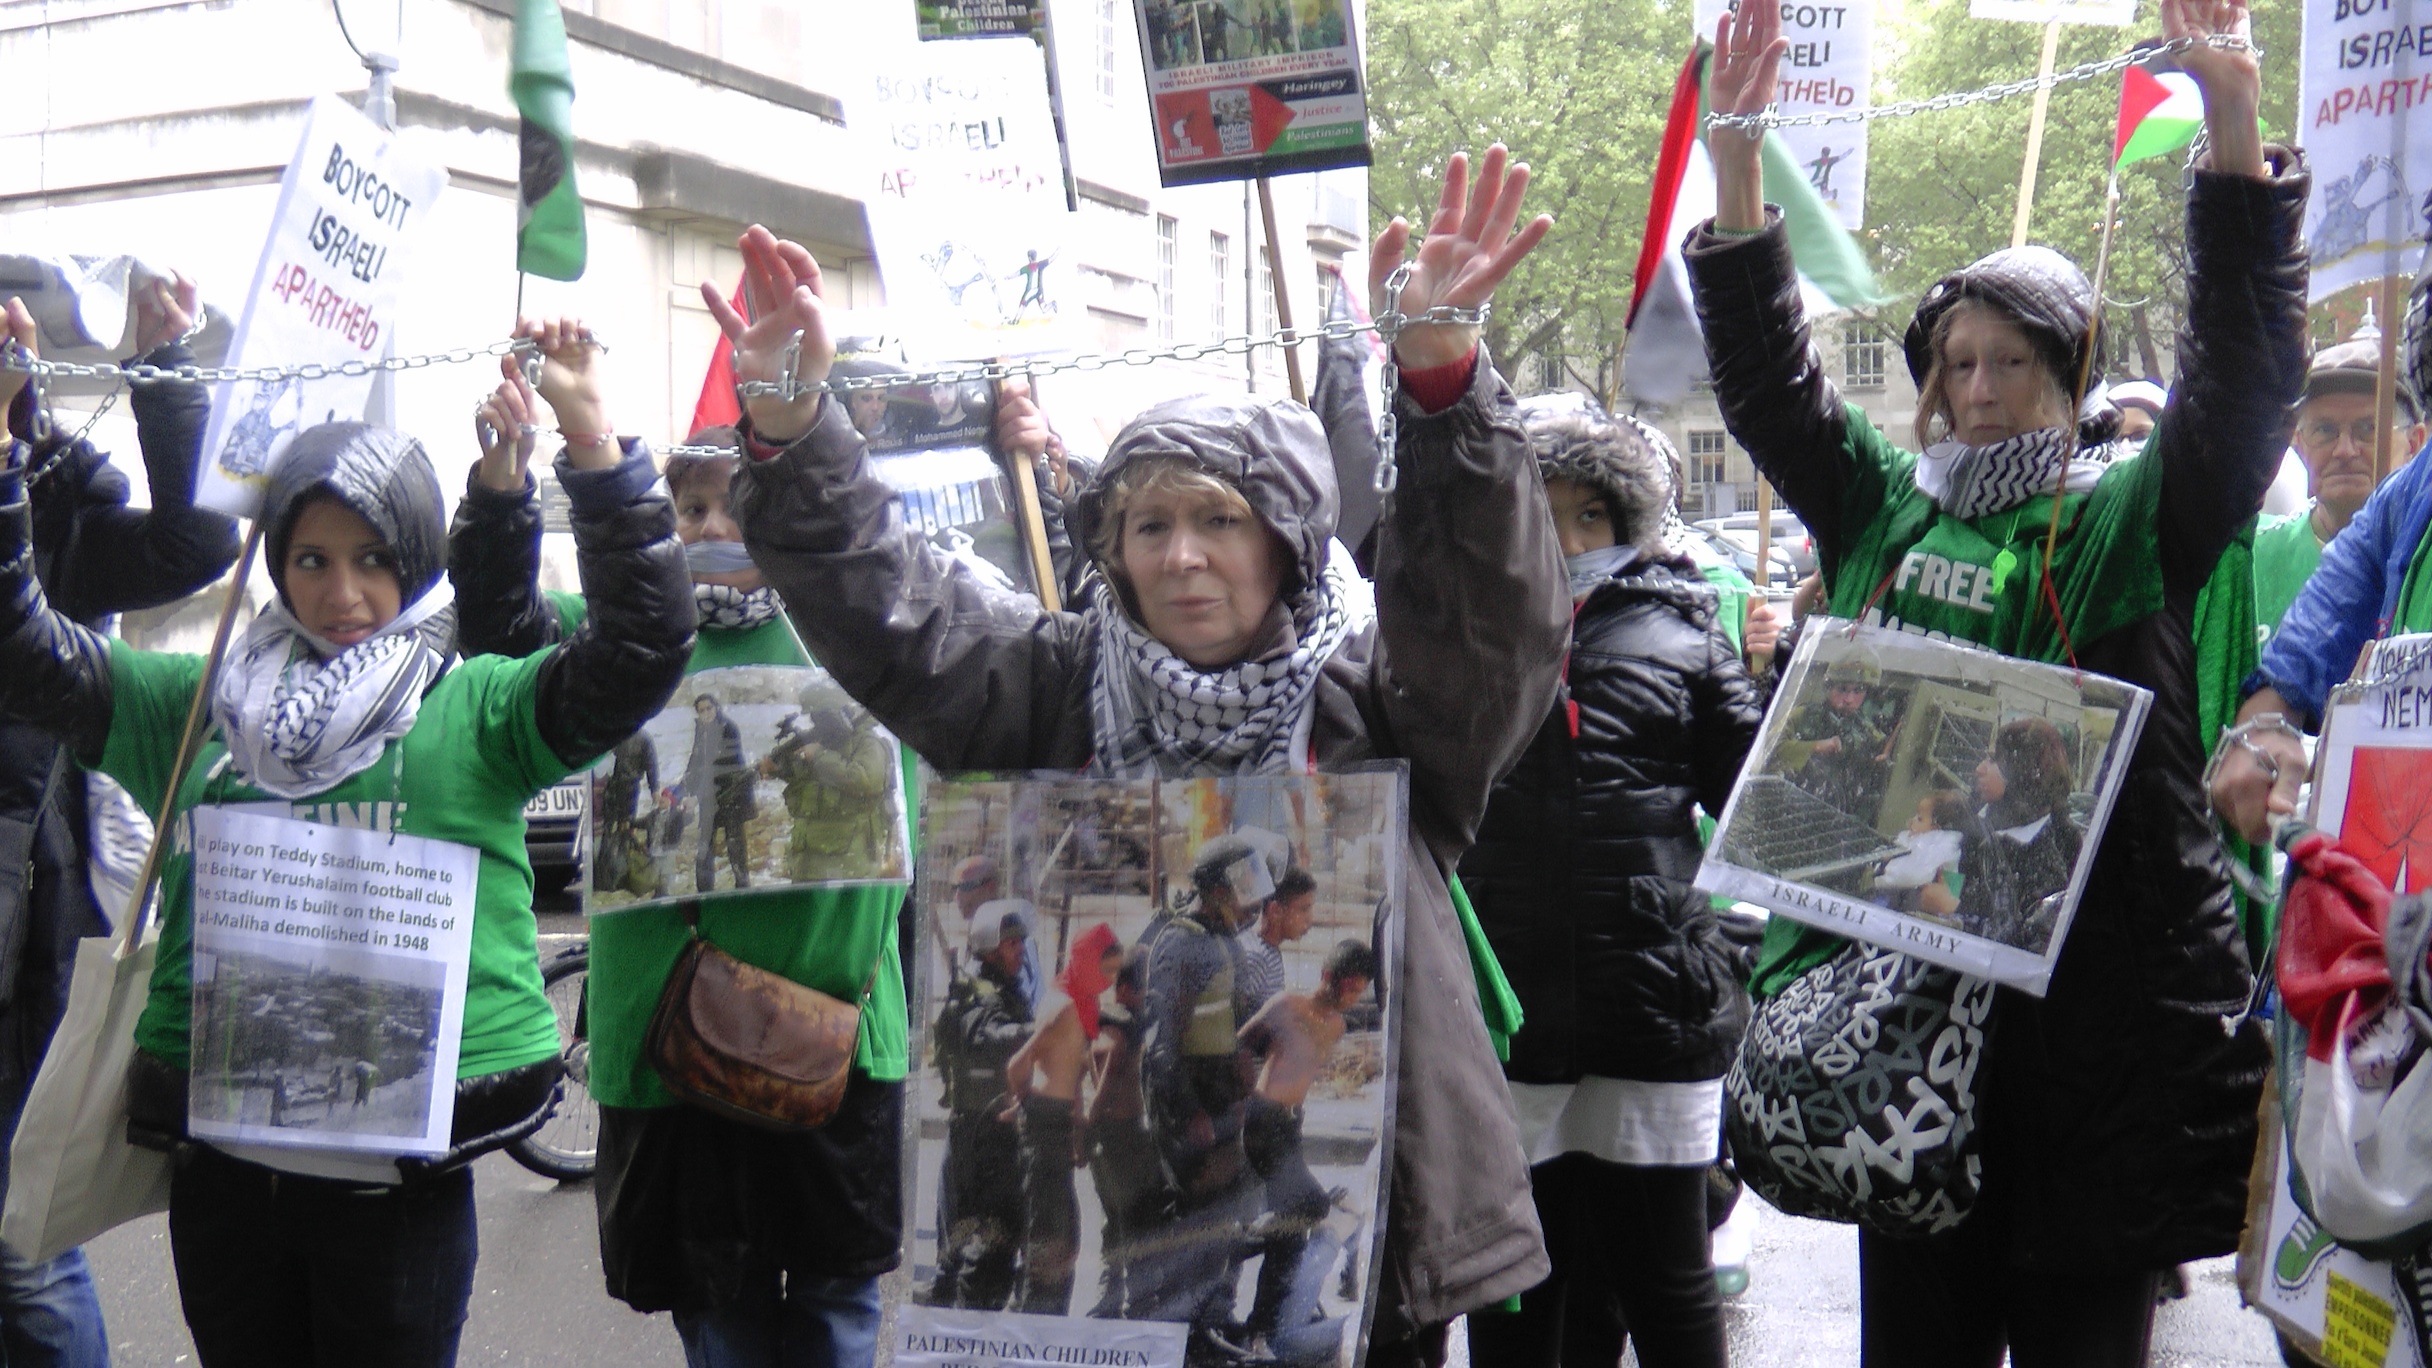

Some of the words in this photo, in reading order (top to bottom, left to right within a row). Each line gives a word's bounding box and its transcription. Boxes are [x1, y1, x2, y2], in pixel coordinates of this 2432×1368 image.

[957, 18, 1015, 31] Children
[1283, 78, 1347, 95] Haringey
[1302, 104, 1342, 119] Justice
[1287, 126, 1354, 142] Palestinians
[323, 142, 411, 232] BOYCOTT
[308, 206, 387, 283] ISRAELI
[272, 262, 379, 351] APARTHEID
[1896, 552, 1995, 613] FREE
[209, 839, 240, 857] play
[244, 845, 264, 857] on
[270, 845, 317, 867] Teddy
[321, 852, 391, 876] Stadium,
[395, 860, 437, 883] home
[440, 871, 453, 883] to
[211, 862, 257, 881] Beitar
[263, 867, 358, 893] Yerushalaim
[363, 881, 422, 902] football
[426, 892, 453, 907] club
[215, 889, 280, 908] stadium
[285, 895, 298, 911] is
[302, 897, 338, 916] built
[344, 906, 364, 919] on
[369, 906, 395, 922] the
[400, 909, 438, 928] lands
[441, 916, 455, 930] of
[1771, 884, 1867, 925] ISRAELI
[1889, 921, 1963, 953] ARMY
[274, 919, 369, 943] demolished
[374, 930, 388, 946] in
[393, 933, 430, 951] 1948
[906, 1334, 1038, 1361] PALESTINIAN
[1042, 1344, 1151, 1367] CHILDREN
